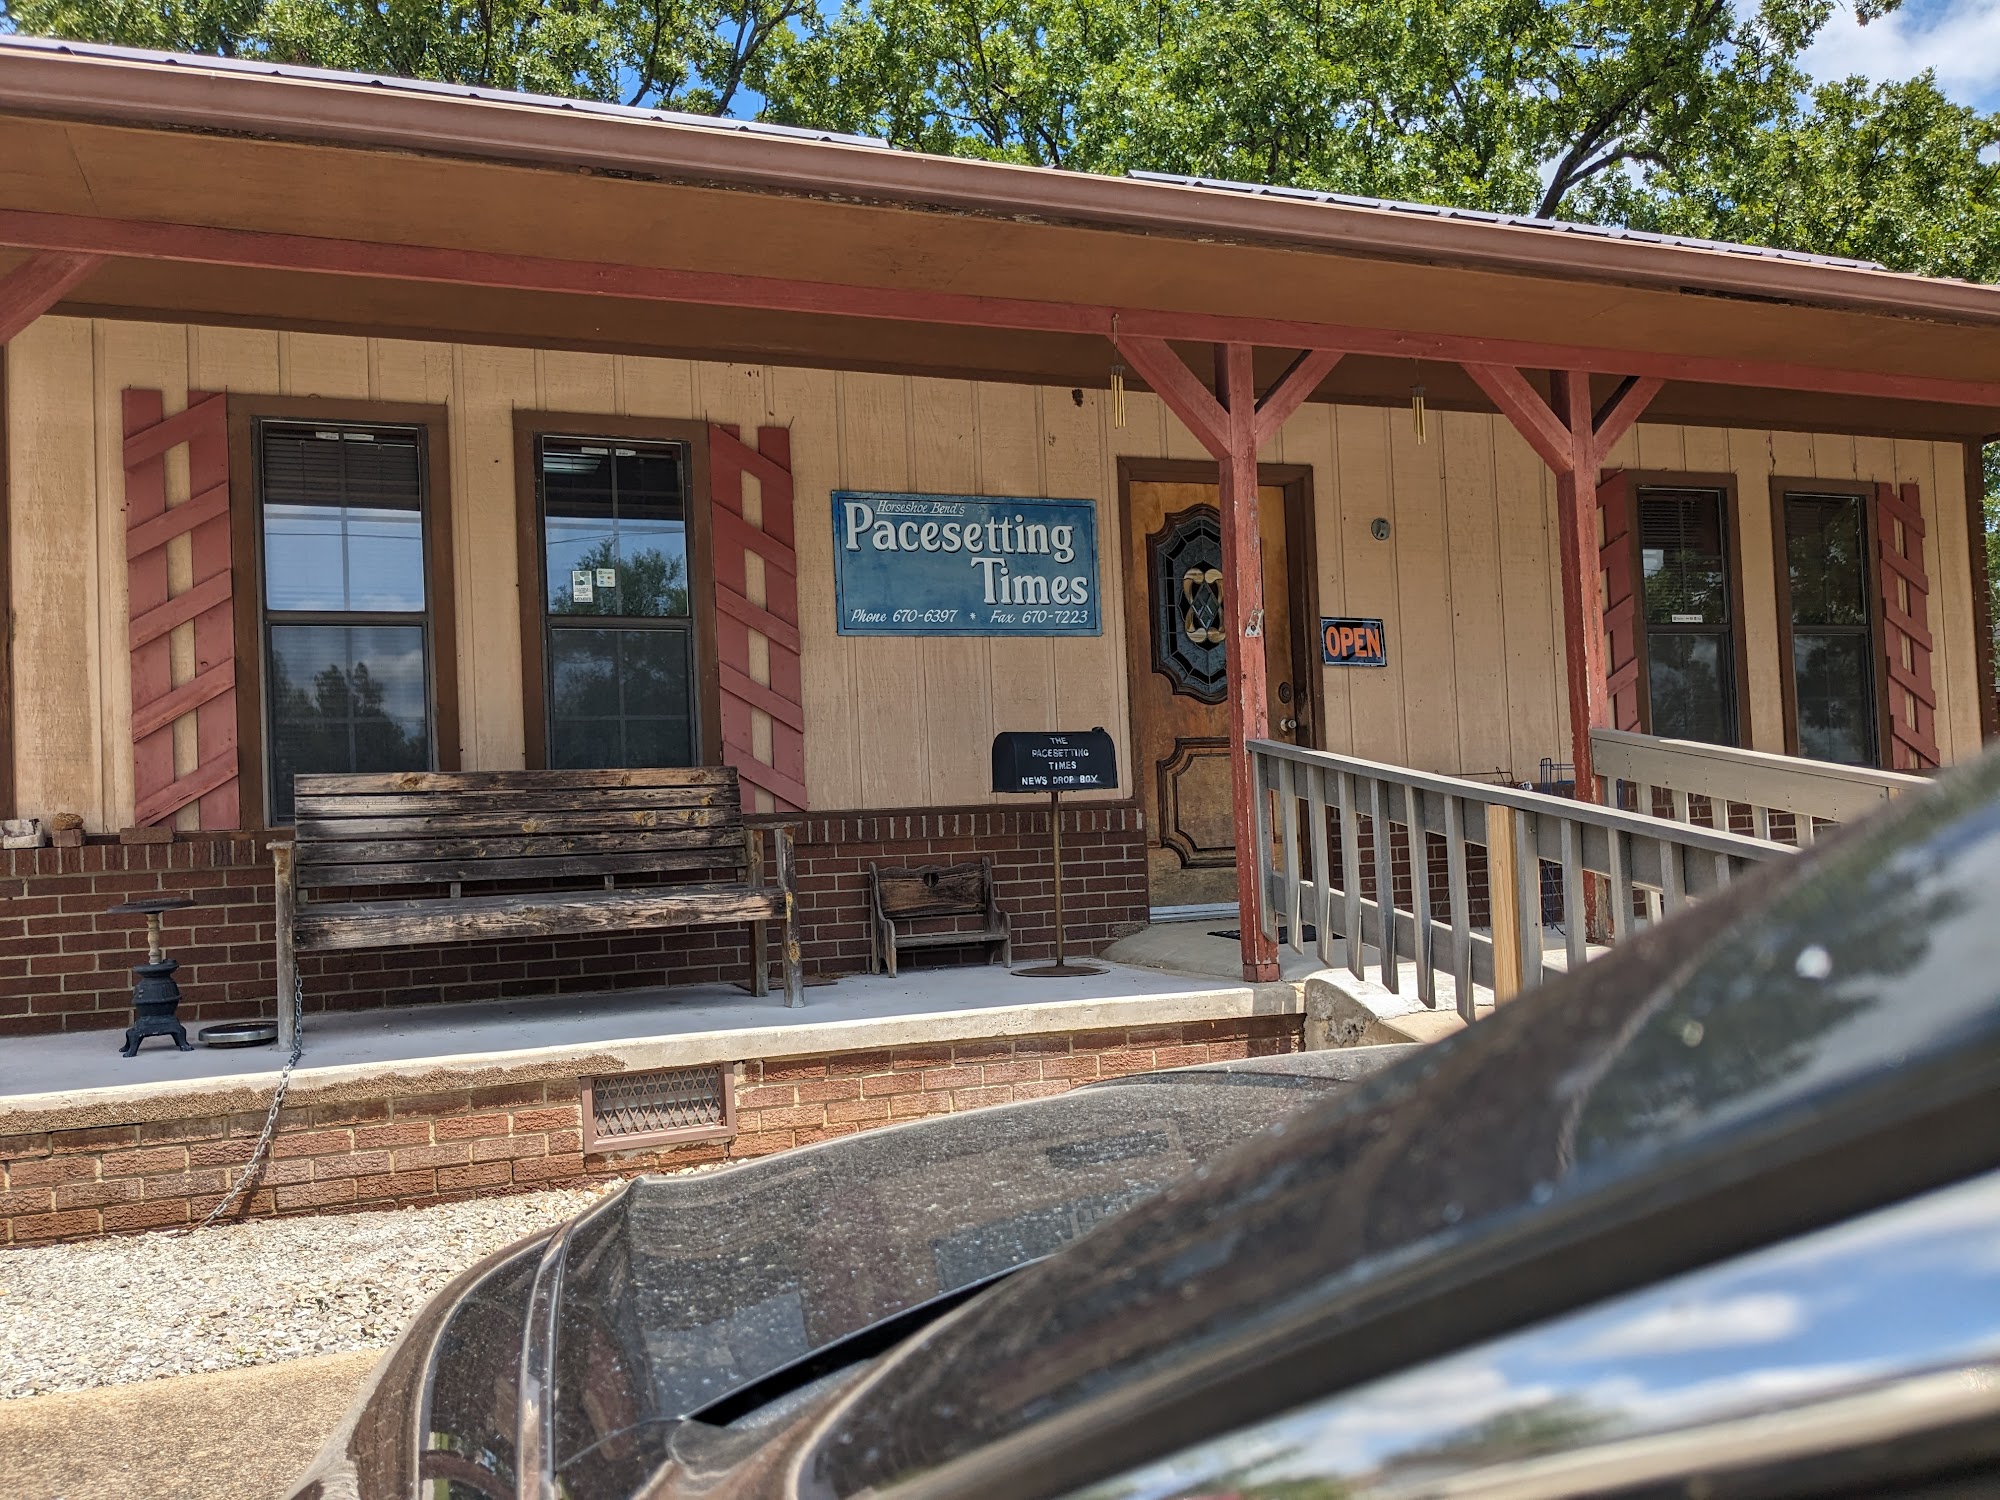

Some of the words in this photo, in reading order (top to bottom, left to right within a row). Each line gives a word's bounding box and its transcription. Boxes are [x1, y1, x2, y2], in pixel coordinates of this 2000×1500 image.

[876, 500, 928, 514] Horseshoe
[930, 502, 965, 515] Bend's
[843, 502, 1076, 564] Pacesetting
[970, 557, 1089, 605] Times
[851, 608, 887, 623] Phone
[892, 609, 958, 623] 670-6397
[990, 610, 1016, 624] Fax
[1021, 610, 1089, 624] 670-7223
[1325, 626, 1381, 657] OPEN
[1049, 737, 1068, 745] THE
[1048, 761, 1077, 770] TIMES
[1021, 776, 1048, 785] NEWS
[1052, 775, 1075, 784] DROP
[1079, 774, 1098, 783] BOX
